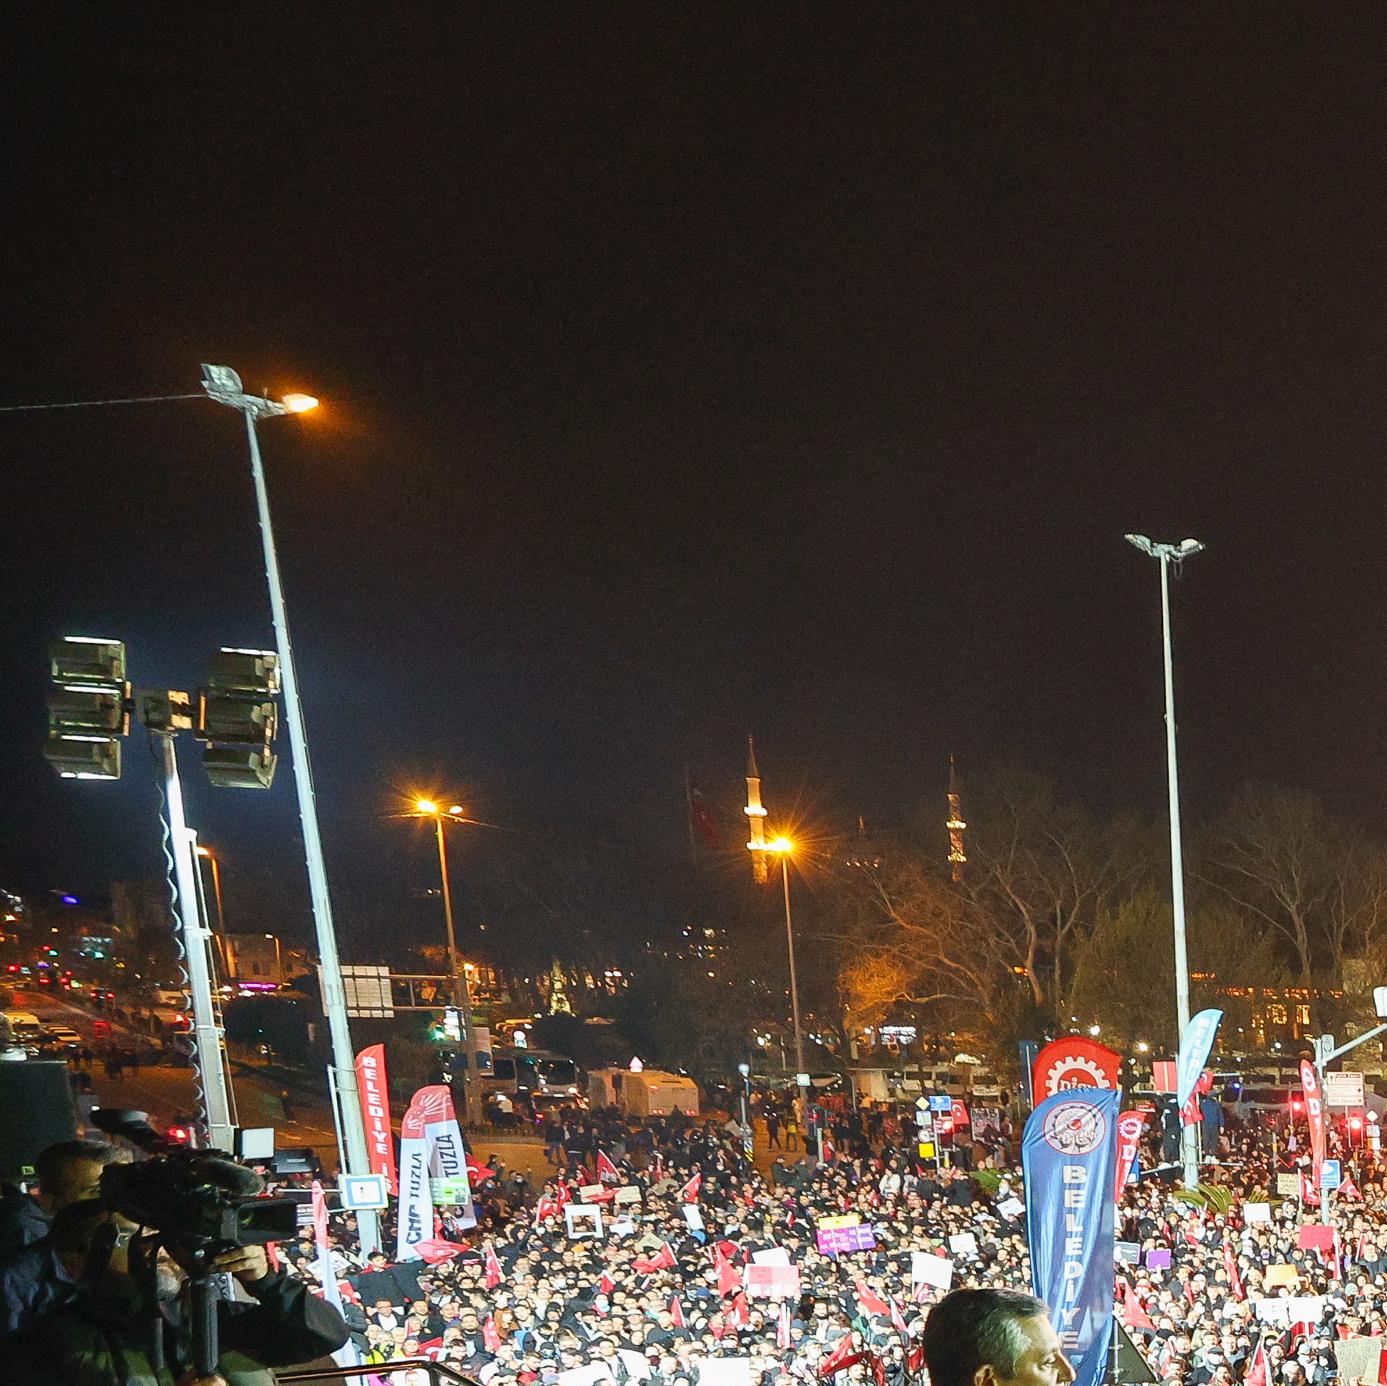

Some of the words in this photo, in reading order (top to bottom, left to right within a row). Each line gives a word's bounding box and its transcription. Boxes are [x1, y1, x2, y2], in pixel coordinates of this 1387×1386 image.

[362, 1056, 389, 1155] BELEDİYE
[436, 1134, 459, 1178] TUZLA
[1060, 1165, 1088, 1349] BELEDİYE
